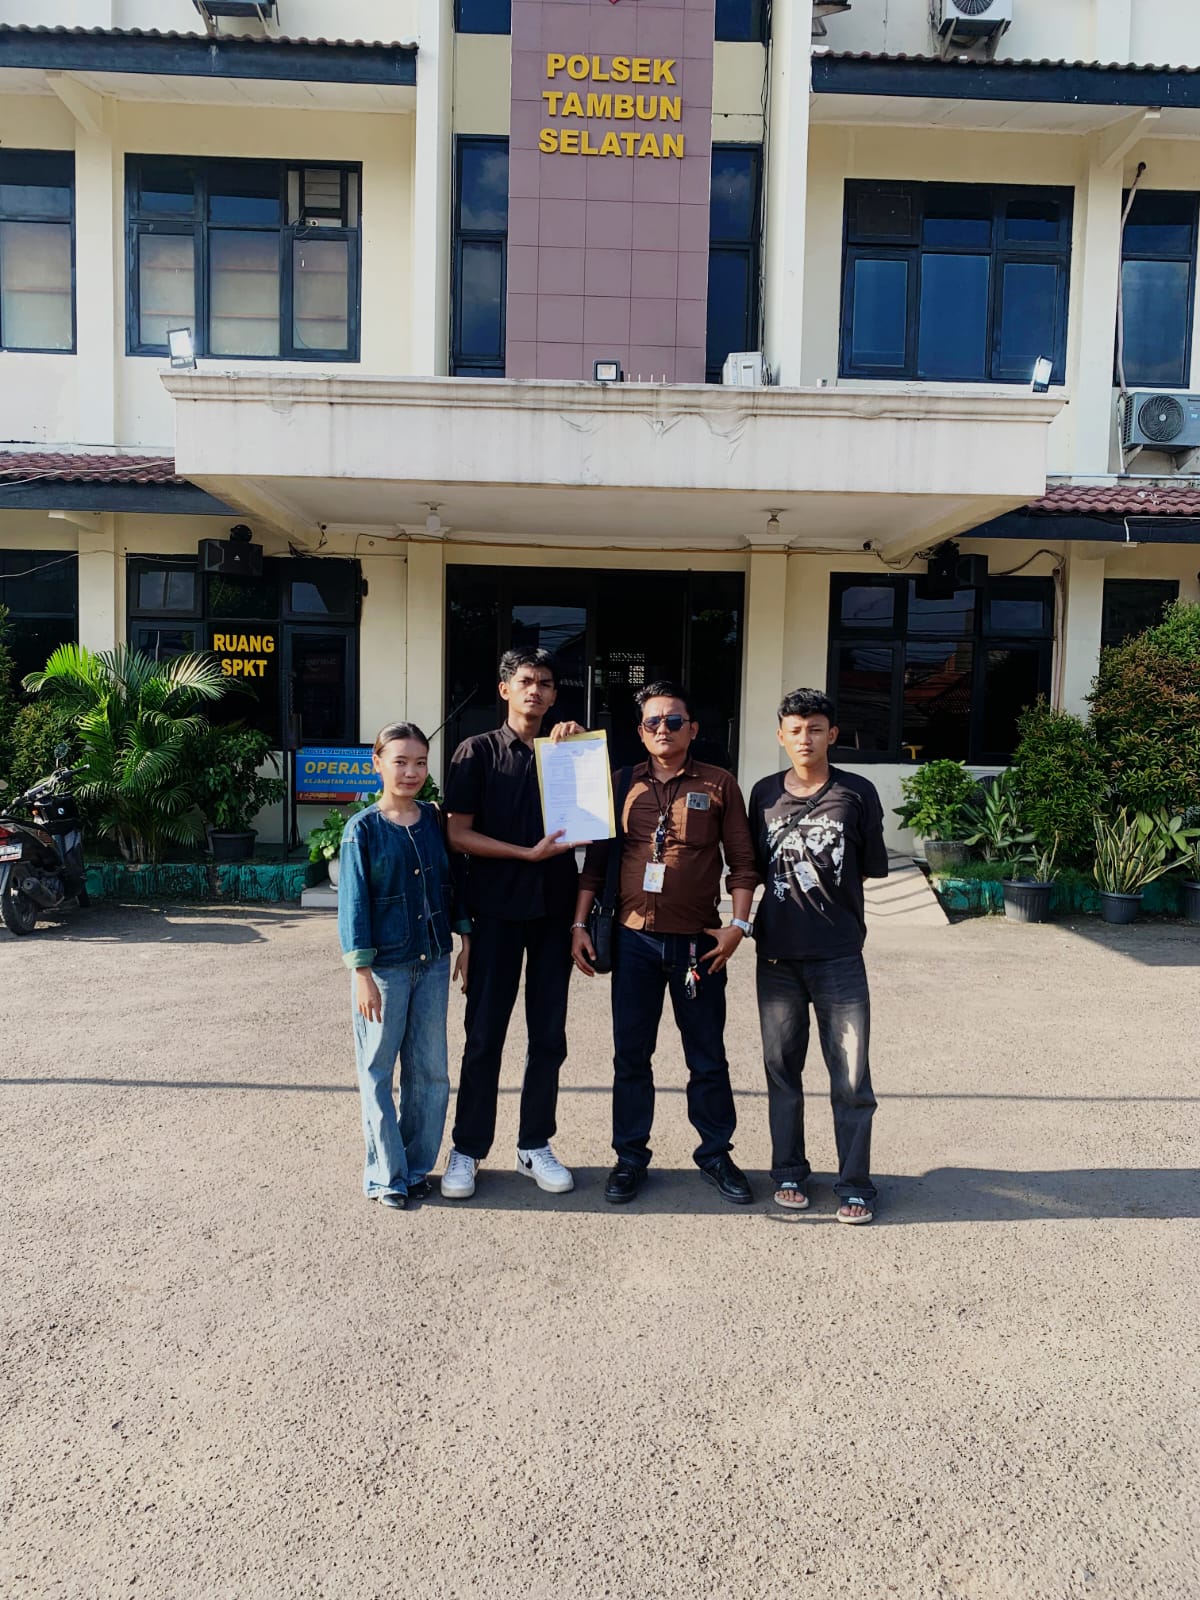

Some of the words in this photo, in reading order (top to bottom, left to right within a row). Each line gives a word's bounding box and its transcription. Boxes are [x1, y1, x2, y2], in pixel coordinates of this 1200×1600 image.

[546, 53, 677, 85] POLSEK
[542, 91, 682, 122] TAMBUN
[538, 128, 685, 159] SELATAN
[213, 633, 275, 653] RUANG
[221, 659, 268, 677] SPKT
